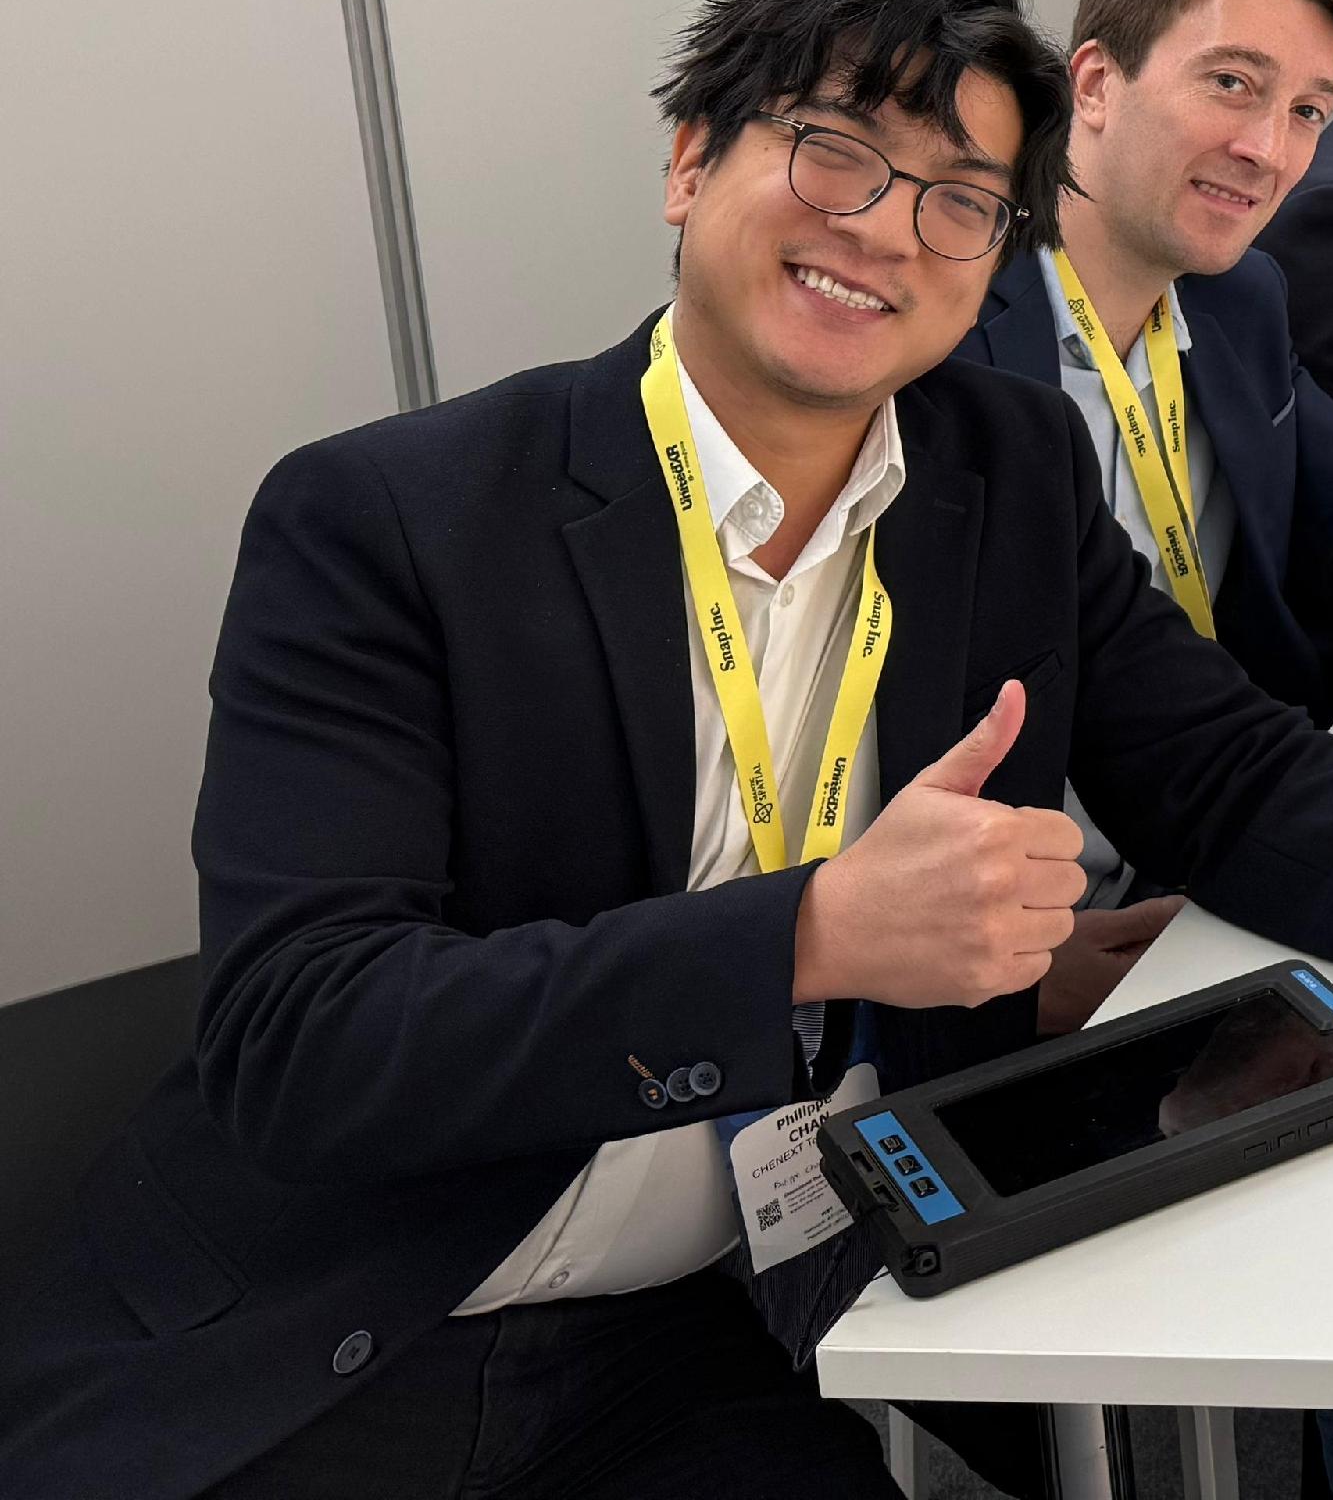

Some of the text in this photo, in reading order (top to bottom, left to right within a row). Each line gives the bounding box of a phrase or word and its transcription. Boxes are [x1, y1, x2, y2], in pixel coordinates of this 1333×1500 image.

[1125, 404, 1147, 457] Snap Inc.
[1168, 400, 1180, 453] Snap Inc.
[666, 444, 692, 511] UnitedXR
[710, 602, 736, 672] Snap Inc.
[862, 591, 884, 658] Snap Inc.
[752, 763, 767, 801] SPATIAL
[823, 757, 847, 827] UnitedXR
[776, 1095, 832, 1131] Philippe
[789, 1111, 830, 1142] CHAN
[752, 1142, 804, 1179] CHENEXT
